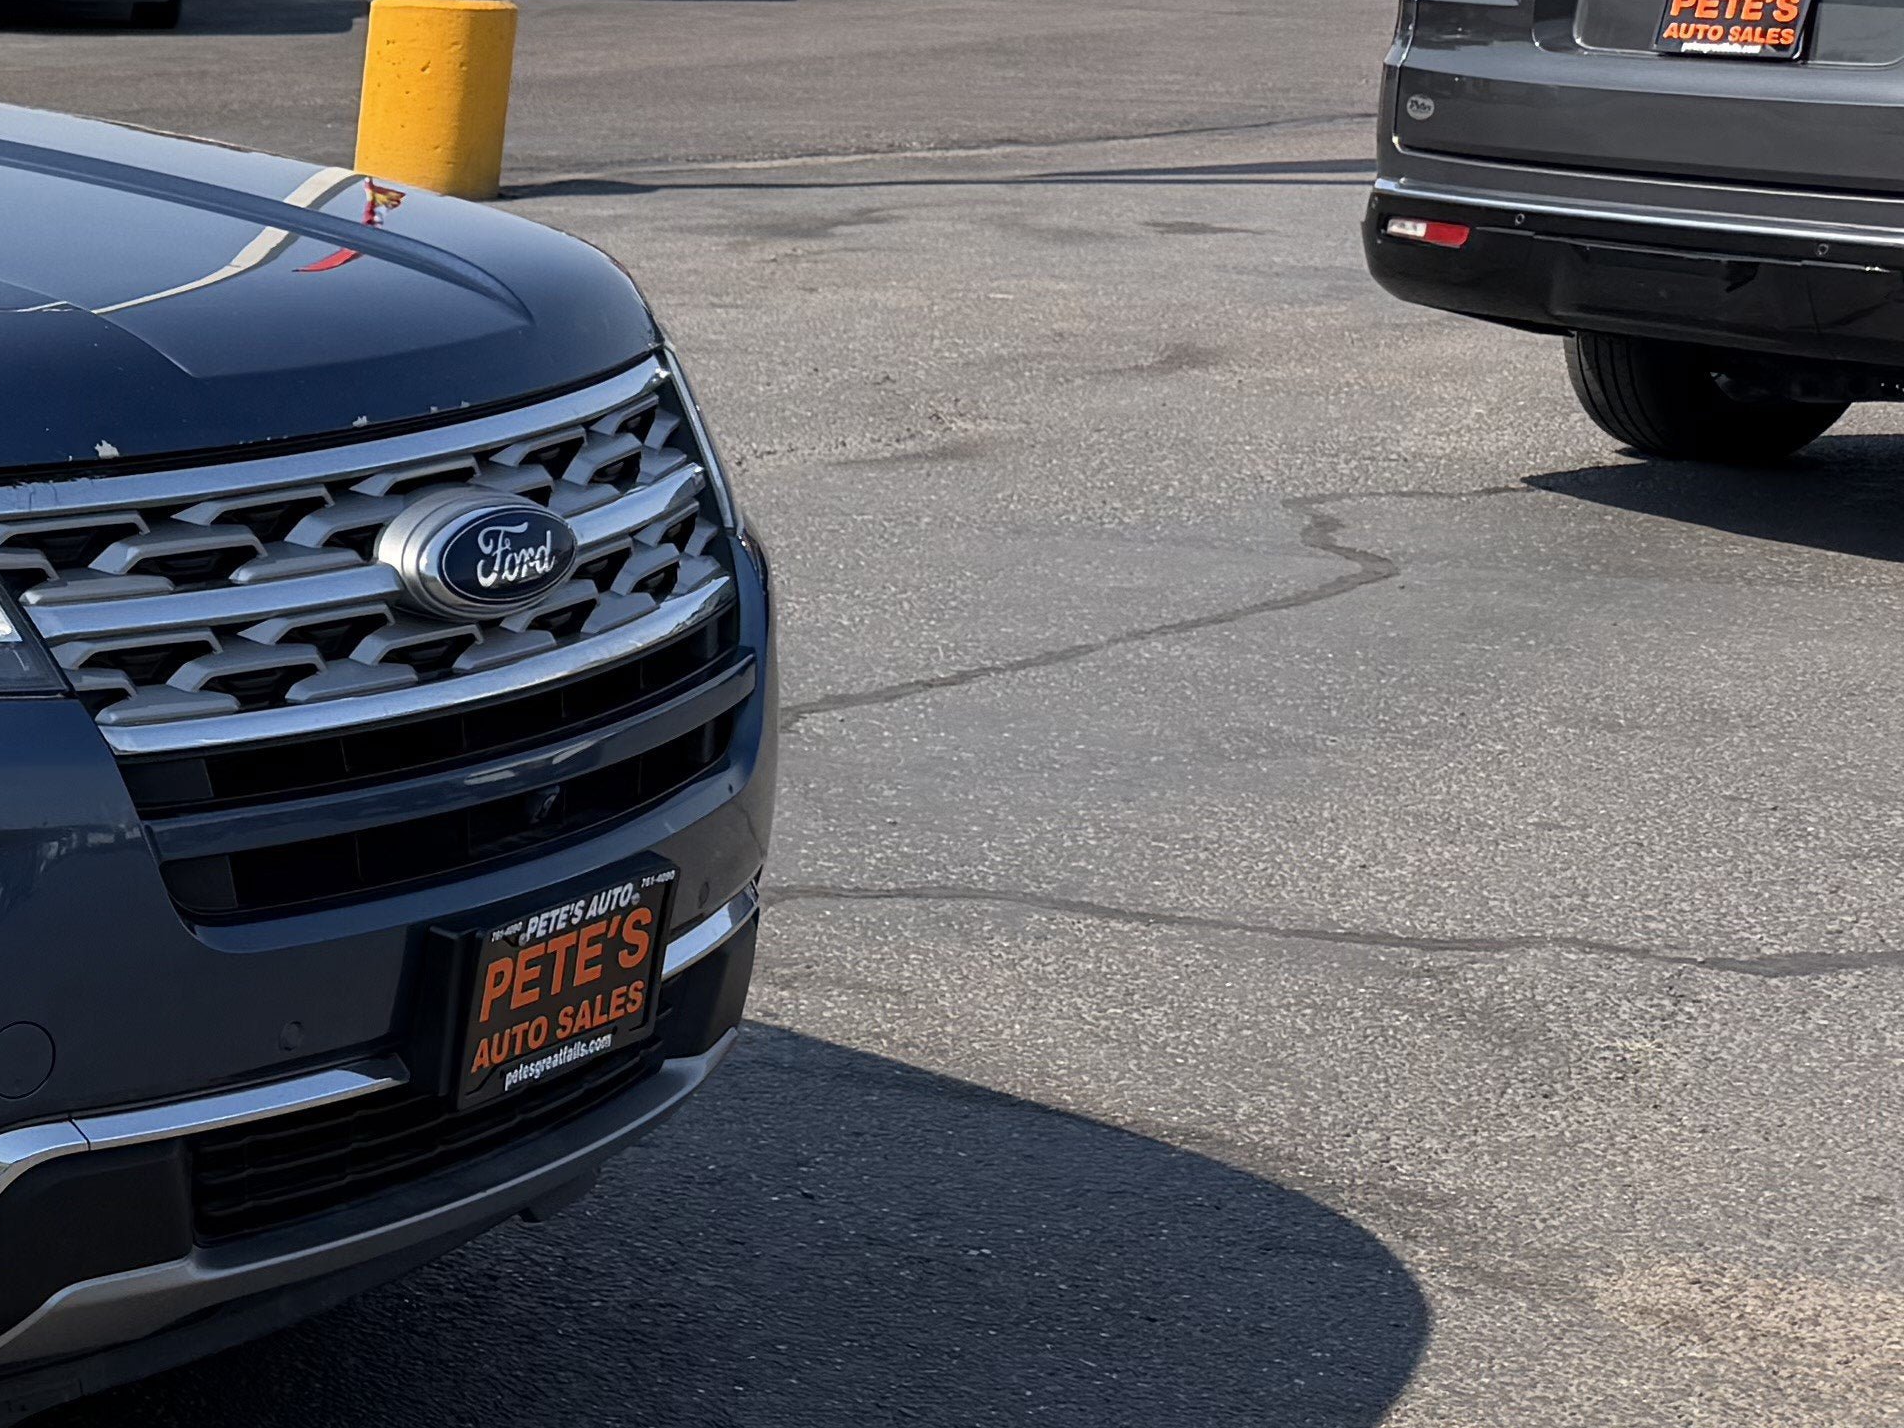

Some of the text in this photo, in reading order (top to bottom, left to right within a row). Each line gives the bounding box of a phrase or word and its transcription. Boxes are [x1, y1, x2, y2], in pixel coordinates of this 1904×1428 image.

[1662, 22, 1795, 45] AUTO SALES
[476, 522, 556, 588] Ford
[525, 899, 586, 942] PETE'S
[585, 883, 633, 920] AUTO
[479, 907, 654, 1023] PETE'S
[470, 980, 646, 1074] AUTO SALES
